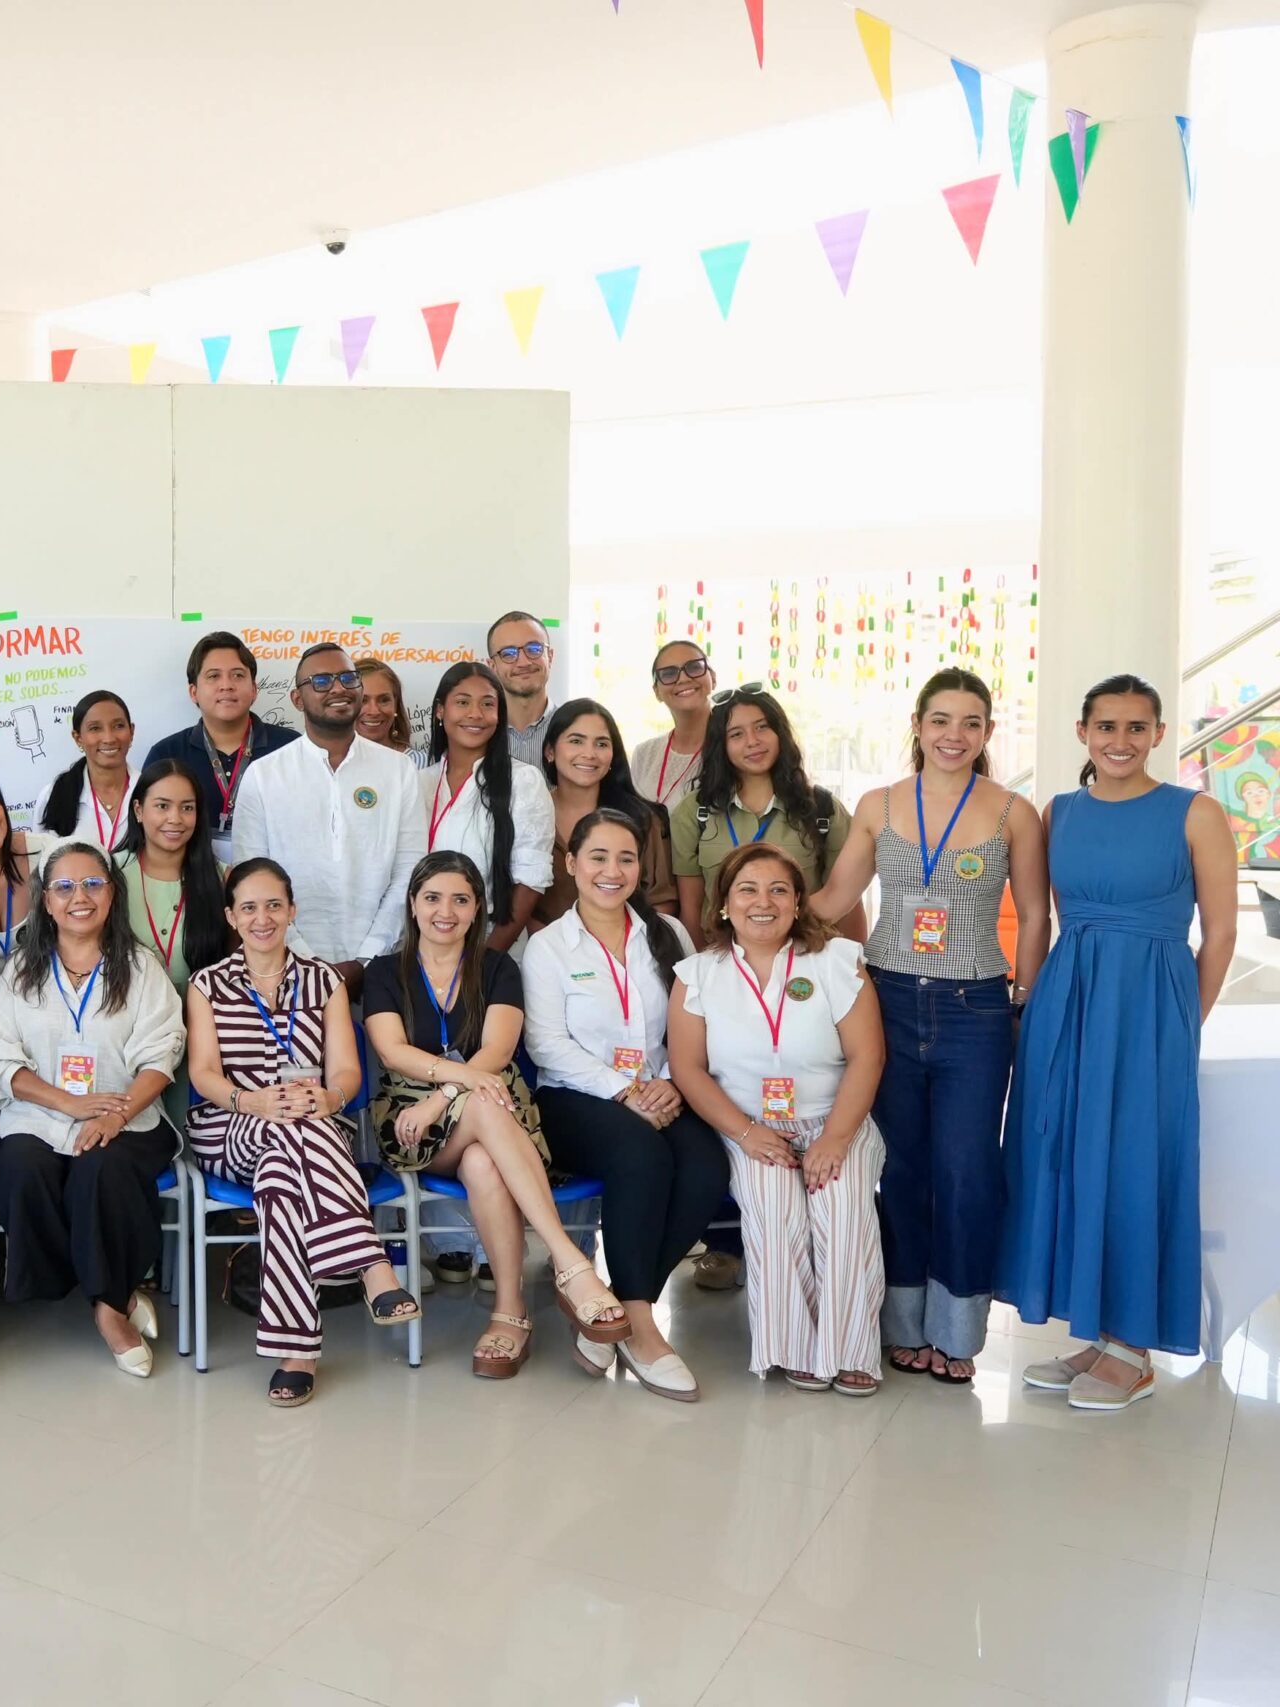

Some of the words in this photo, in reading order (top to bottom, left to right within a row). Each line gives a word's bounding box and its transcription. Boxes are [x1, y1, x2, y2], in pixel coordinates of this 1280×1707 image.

[242, 628, 295, 643] TENGO
[300, 626, 372, 648] INTERÉS
[380, 632, 401, 646] DE
[250, 646, 300, 660] EGUIR
[4, 672, 21, 685] NO
[25, 664, 87, 681] PODEMOS
